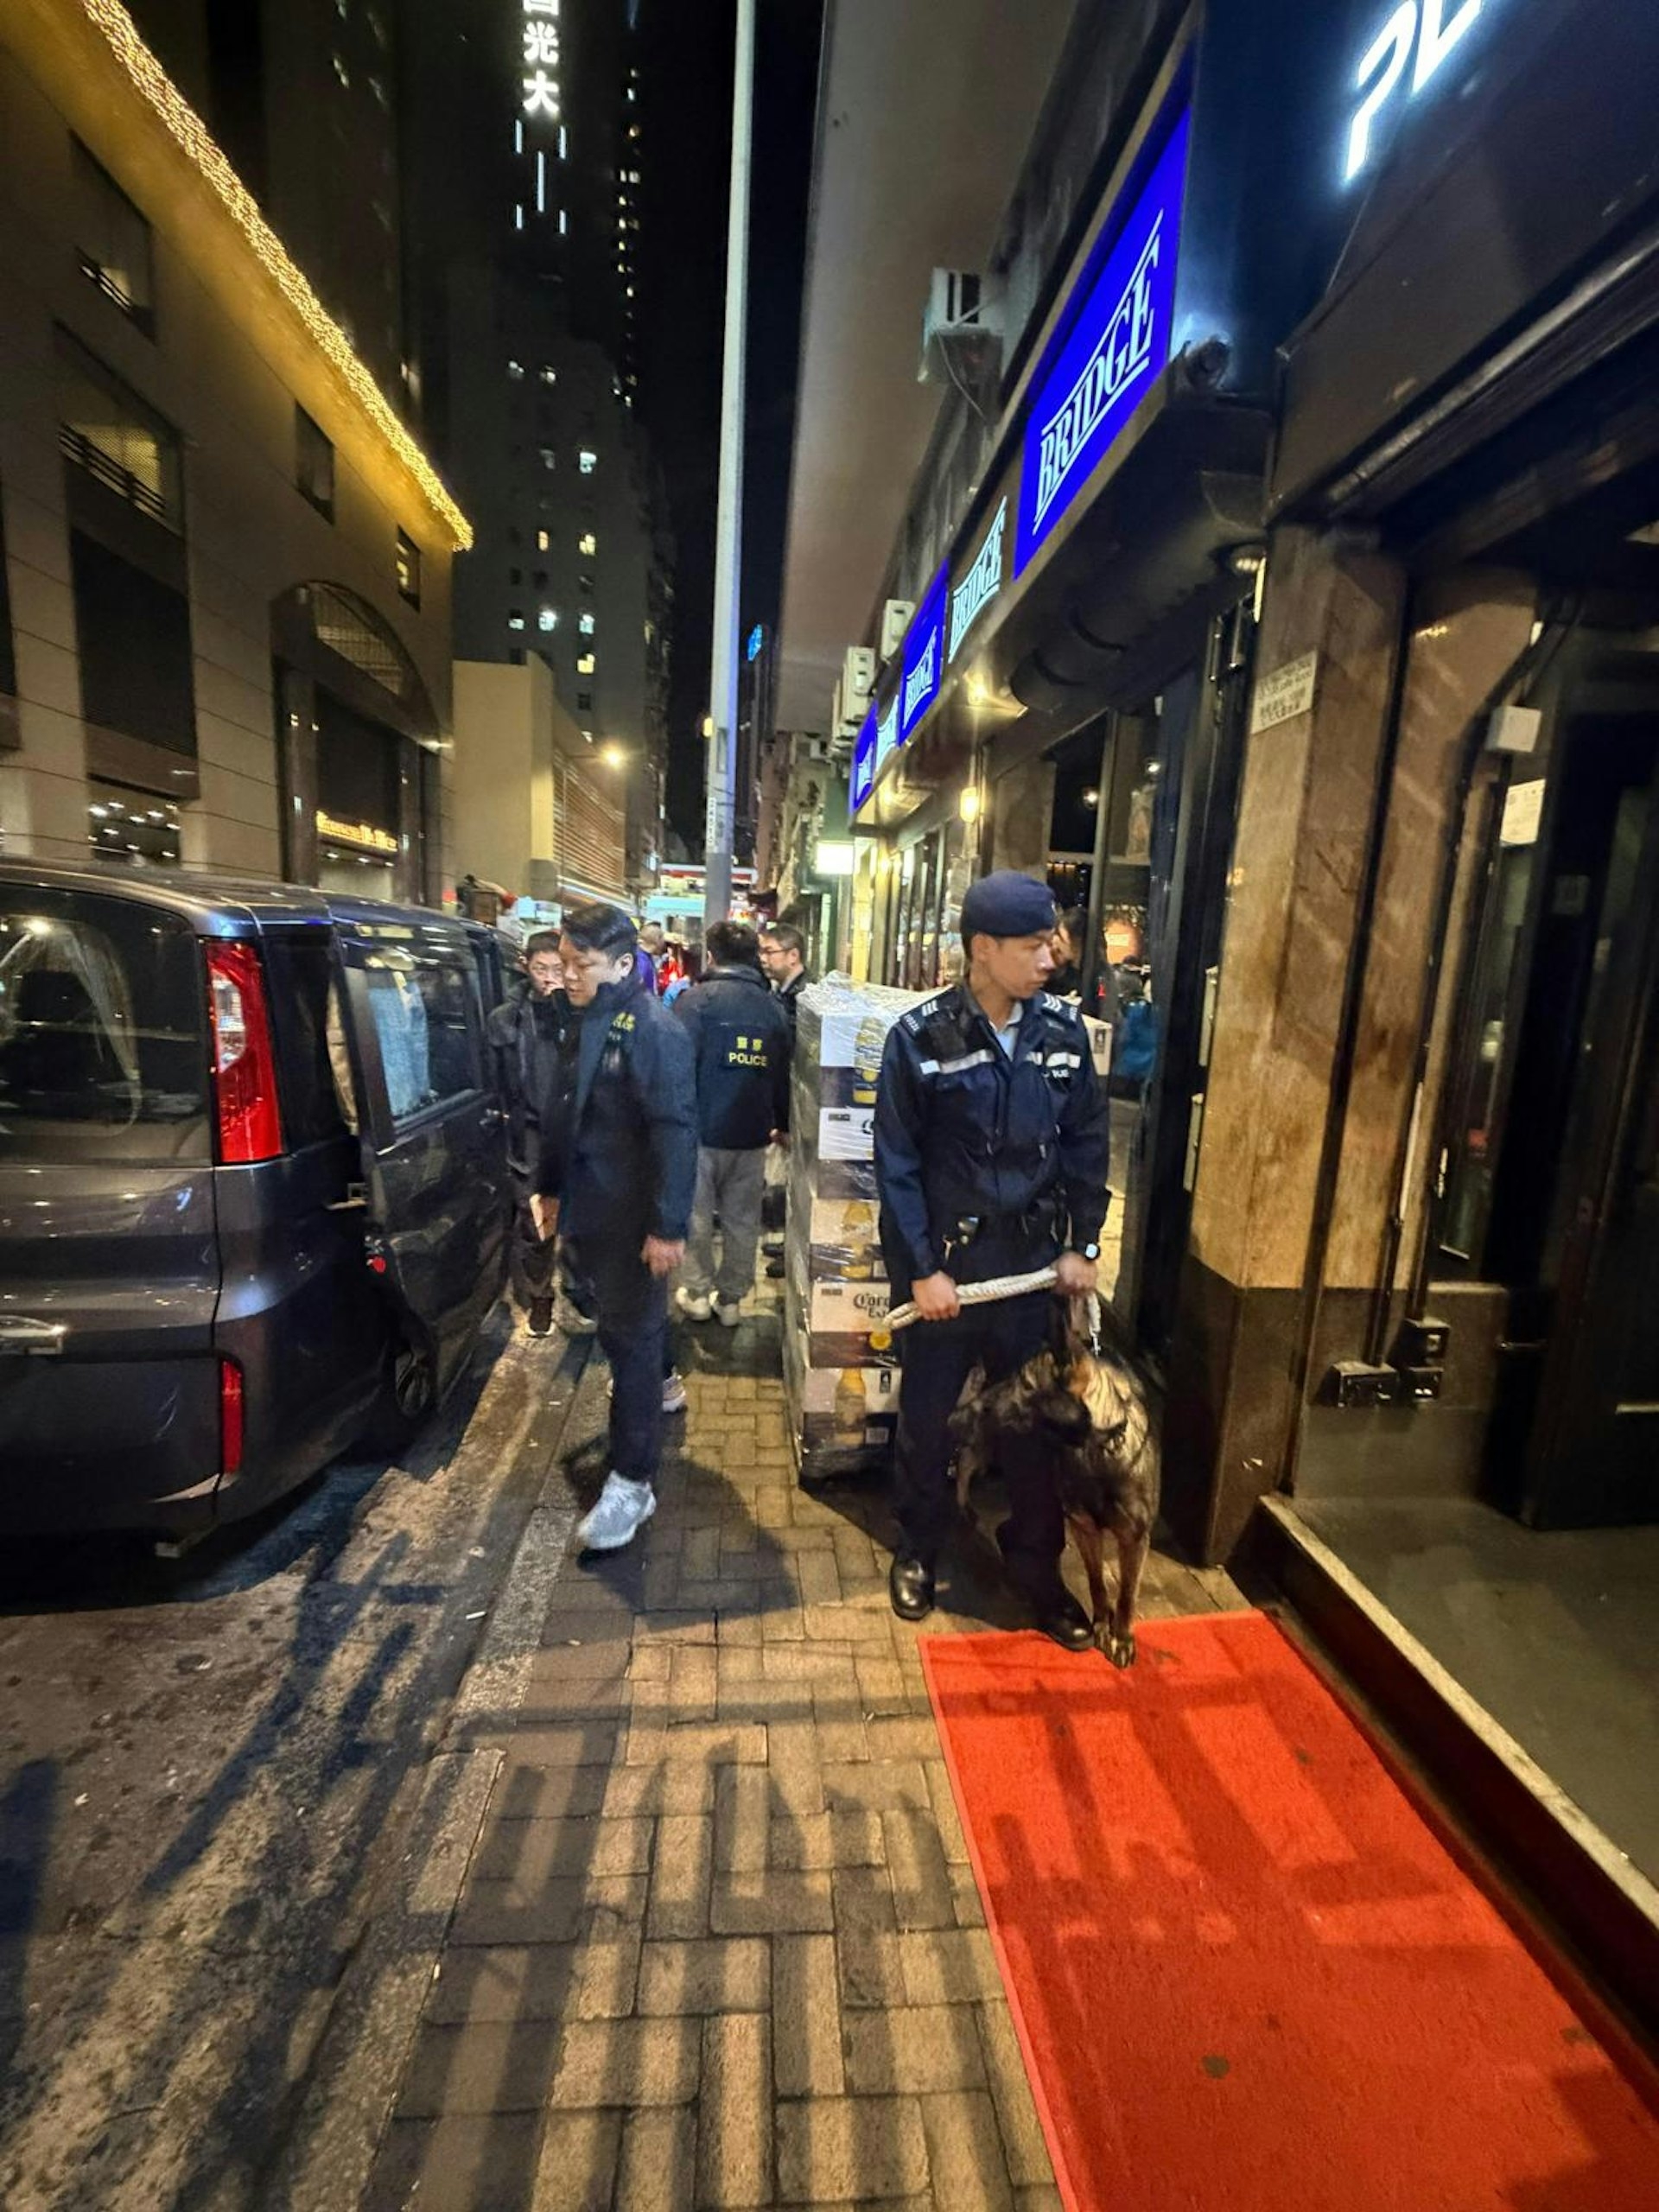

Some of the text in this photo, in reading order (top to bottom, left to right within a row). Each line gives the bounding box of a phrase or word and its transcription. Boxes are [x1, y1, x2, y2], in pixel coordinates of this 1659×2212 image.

[522, 0, 560, 114] 光大
[1033, 226, 1160, 525] BRIDGE
[949, 503, 1007, 658] BRIDGE
[728, 1051, 767, 1067] POLICE
